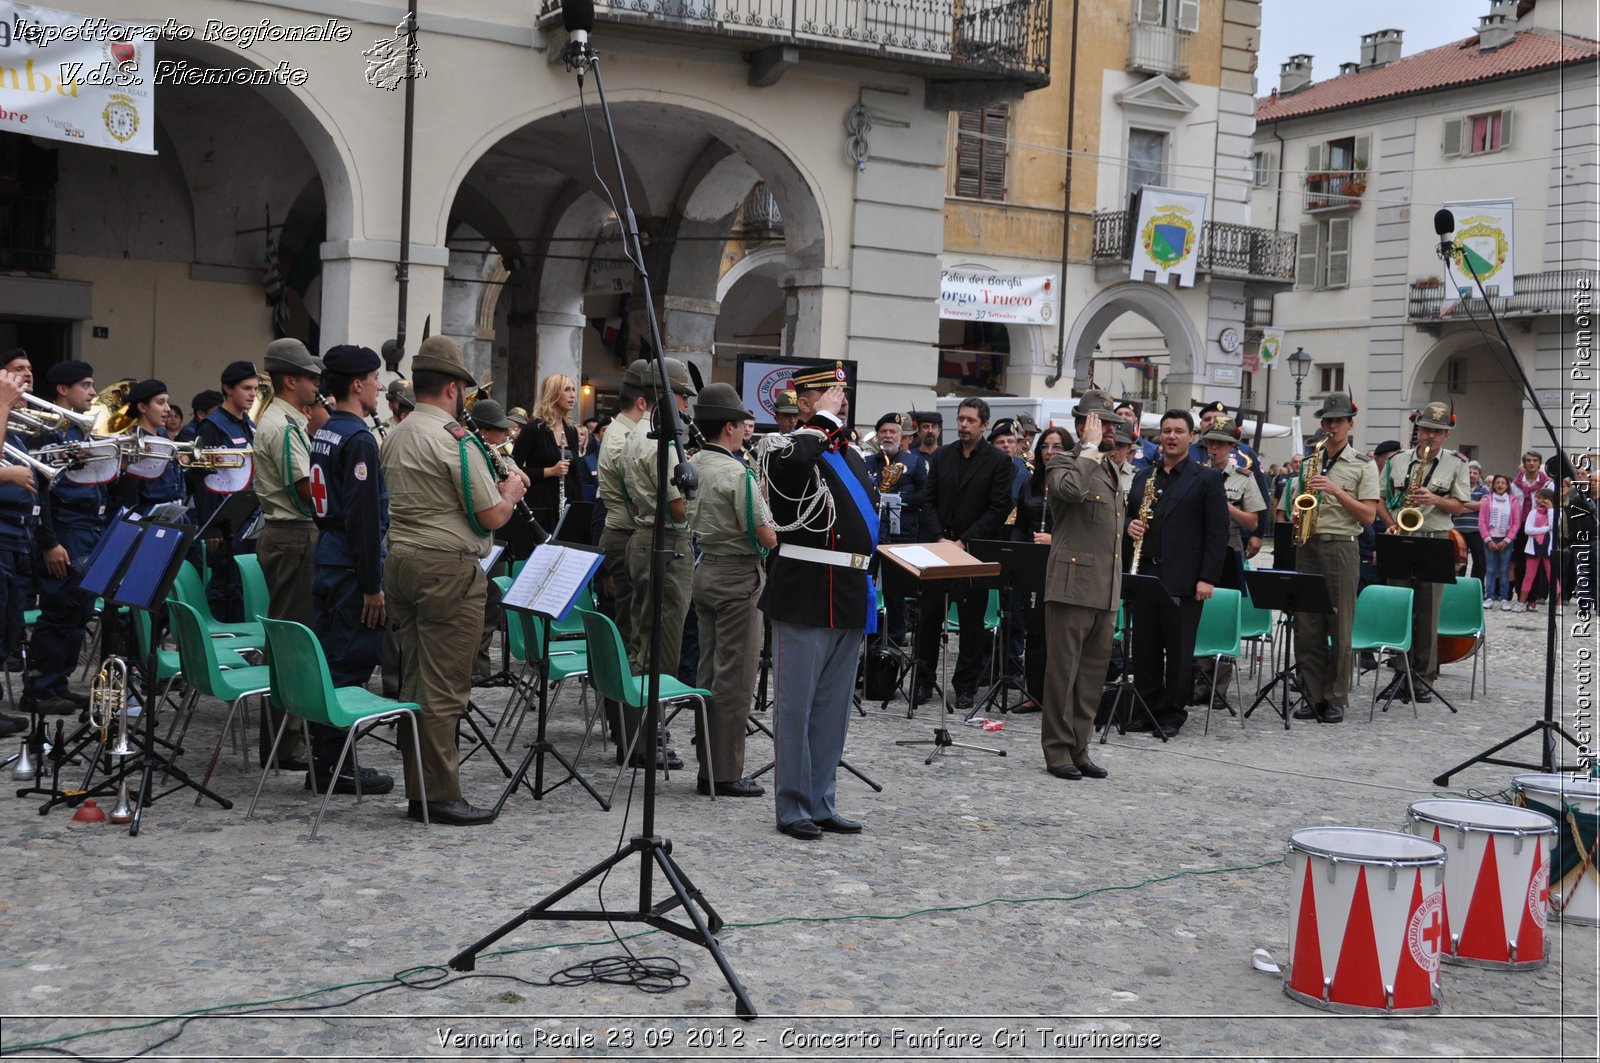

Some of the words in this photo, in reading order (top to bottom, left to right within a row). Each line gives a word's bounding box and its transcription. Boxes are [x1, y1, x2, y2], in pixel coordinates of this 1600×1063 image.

[941, 271, 964, 283] Palio
[969, 274, 985, 285] dei
[988, 275, 1022, 289] Borghi
[980, 288, 1032, 307] Trucco
